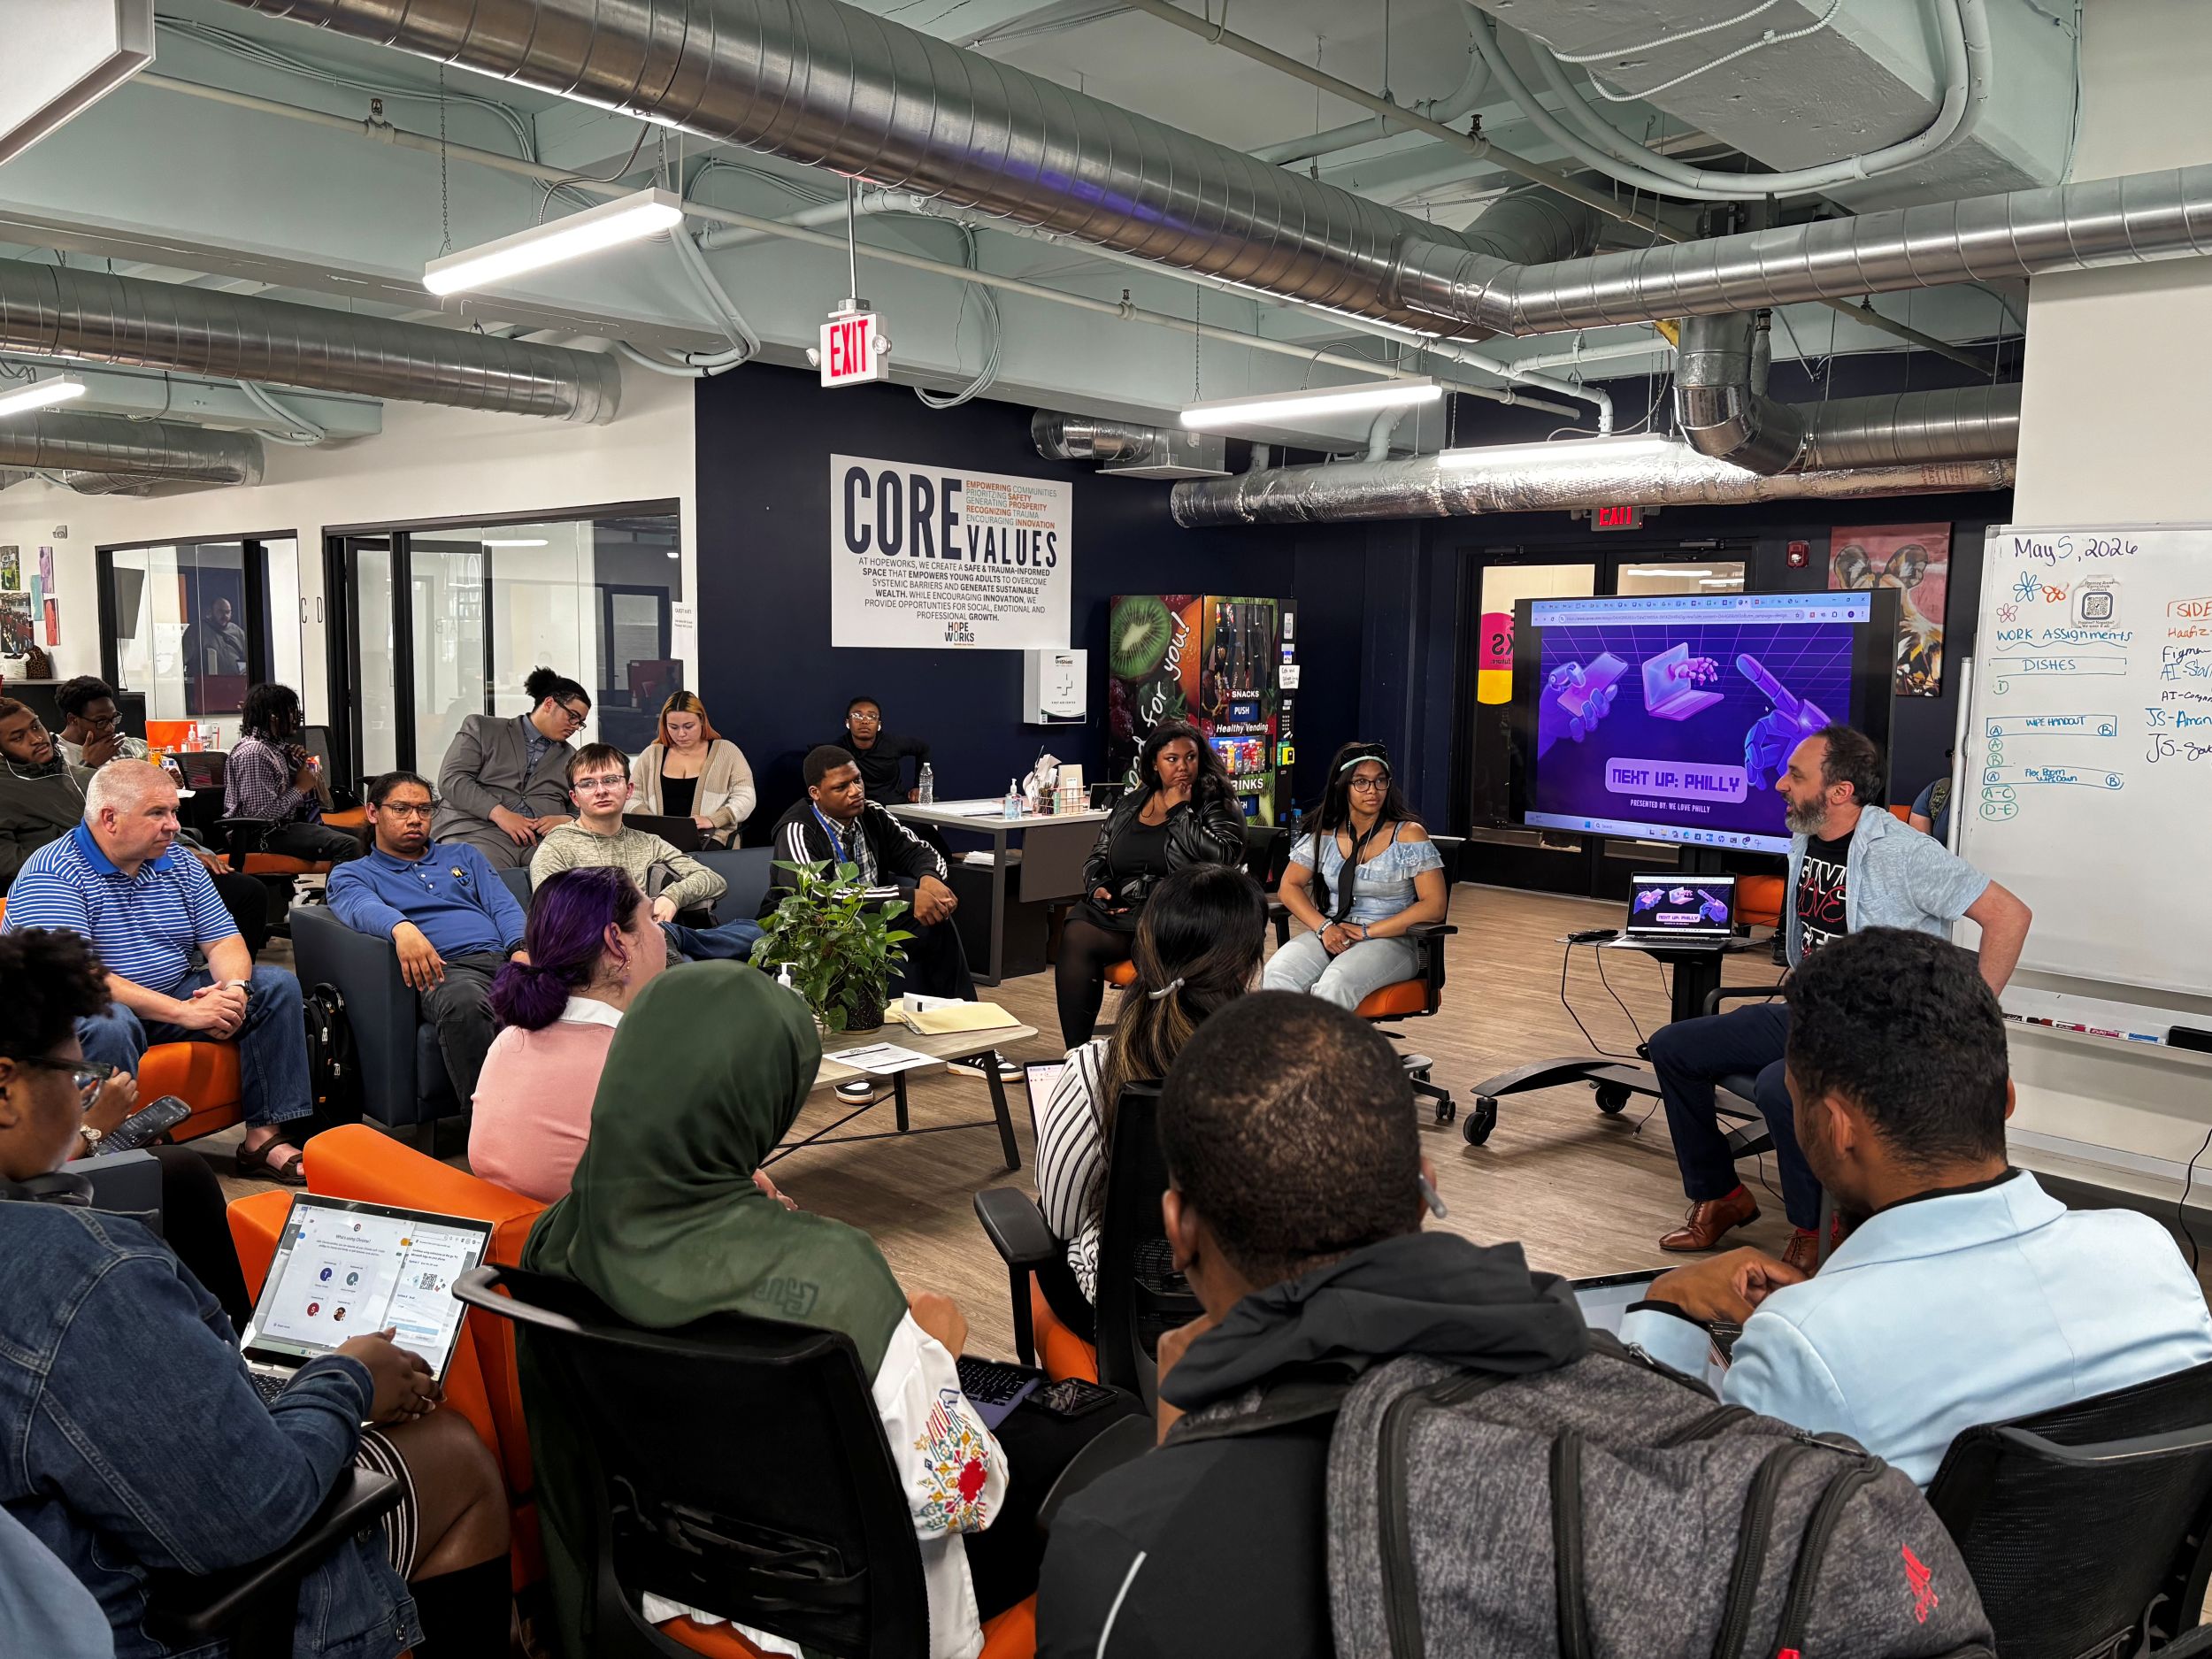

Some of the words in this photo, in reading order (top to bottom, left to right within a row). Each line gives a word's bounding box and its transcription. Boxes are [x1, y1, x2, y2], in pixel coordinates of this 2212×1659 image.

[830, 319, 868, 377] EXIT
[966, 480, 1011, 492] EMPOWERING
[1013, 486, 1057, 497] COMMUNITIES
[966, 496, 1008, 508] GENERATING
[1009, 501, 1048, 511] PROSPERITY
[1008, 493, 1032, 502] SAFETY
[844, 466, 962, 560] CORE
[966, 505, 1011, 516] RECOGNIZING
[1013, 510, 1039, 518] TRAUMA
[966, 514, 1014, 526] ENCOURAGING
[1015, 519, 1056, 529] INNOVATION
[967, 525, 1057, 568] VALUES
[2015, 537, 2055, 566] May
[2085, 537, 2139, 557] 2026
[870, 558, 918, 570] HOPEWORKS,
[918, 561, 930, 570] WE
[931, 562, 956, 572] CREATE
[982, 565, 987, 573] &
[987, 565, 1050, 577] TRAUMA-INFORMED
[863, 568, 887, 577] SPACE
[888, 569, 907, 578] THAT
[909, 571, 949, 580] EMPOWERS
[949, 573, 974, 582] YOUNG
[1012, 577, 1048, 586] OVERCOME
[872, 579, 909, 588] SYSTEMIC
[910, 580, 943, 590] BARRIERS
[960, 583, 995, 593] GENERATE
[995, 586, 1040, 595] SUSTAINABLE
[875, 589, 908, 599] WEALTH.
[909, 591, 932, 600] WHILE
[933, 592, 982, 602] ENCOURAGING
[983, 595, 1026, 604] INNOVATION,
[301, 597, 308, 624] C
[316, 596, 324, 624] D
[864, 599, 897, 609] PROVIDE
[967, 603, 993, 613] SOCIAL,
[994, 604, 1031, 614] EMOTIONAL
[2177, 601, 2212, 618] SIDE
[917, 611, 968, 621] PROFESSIONAL
[969, 613, 1000, 622] GROWTH.
[948, 622, 969, 632] HOPE
[944, 632, 975, 642] WORKS
[1997, 630, 2033, 641] WORK
[1141, 681, 1167, 728] for
[1164, 611, 1190, 681] you!
[2022, 659, 2077, 672] DISHES
[1234, 706, 1250, 715] PUSH
[1217, 724, 1244, 734] Healthy
[1246, 722, 1269, 733] Vending
[2047, 716, 2086, 726] HANDOUT
[1231, 778, 1263, 791] RINKS
[1612, 768, 1650, 786] NEXT
[1655, 771, 1678, 788] UP:
[1684, 773, 1740, 793] PHILLY
[1630, 799, 1658, 809] PRESENTED
[1678, 803, 1691, 812] LOVE
[1692, 805, 1710, 814] PHILLY
